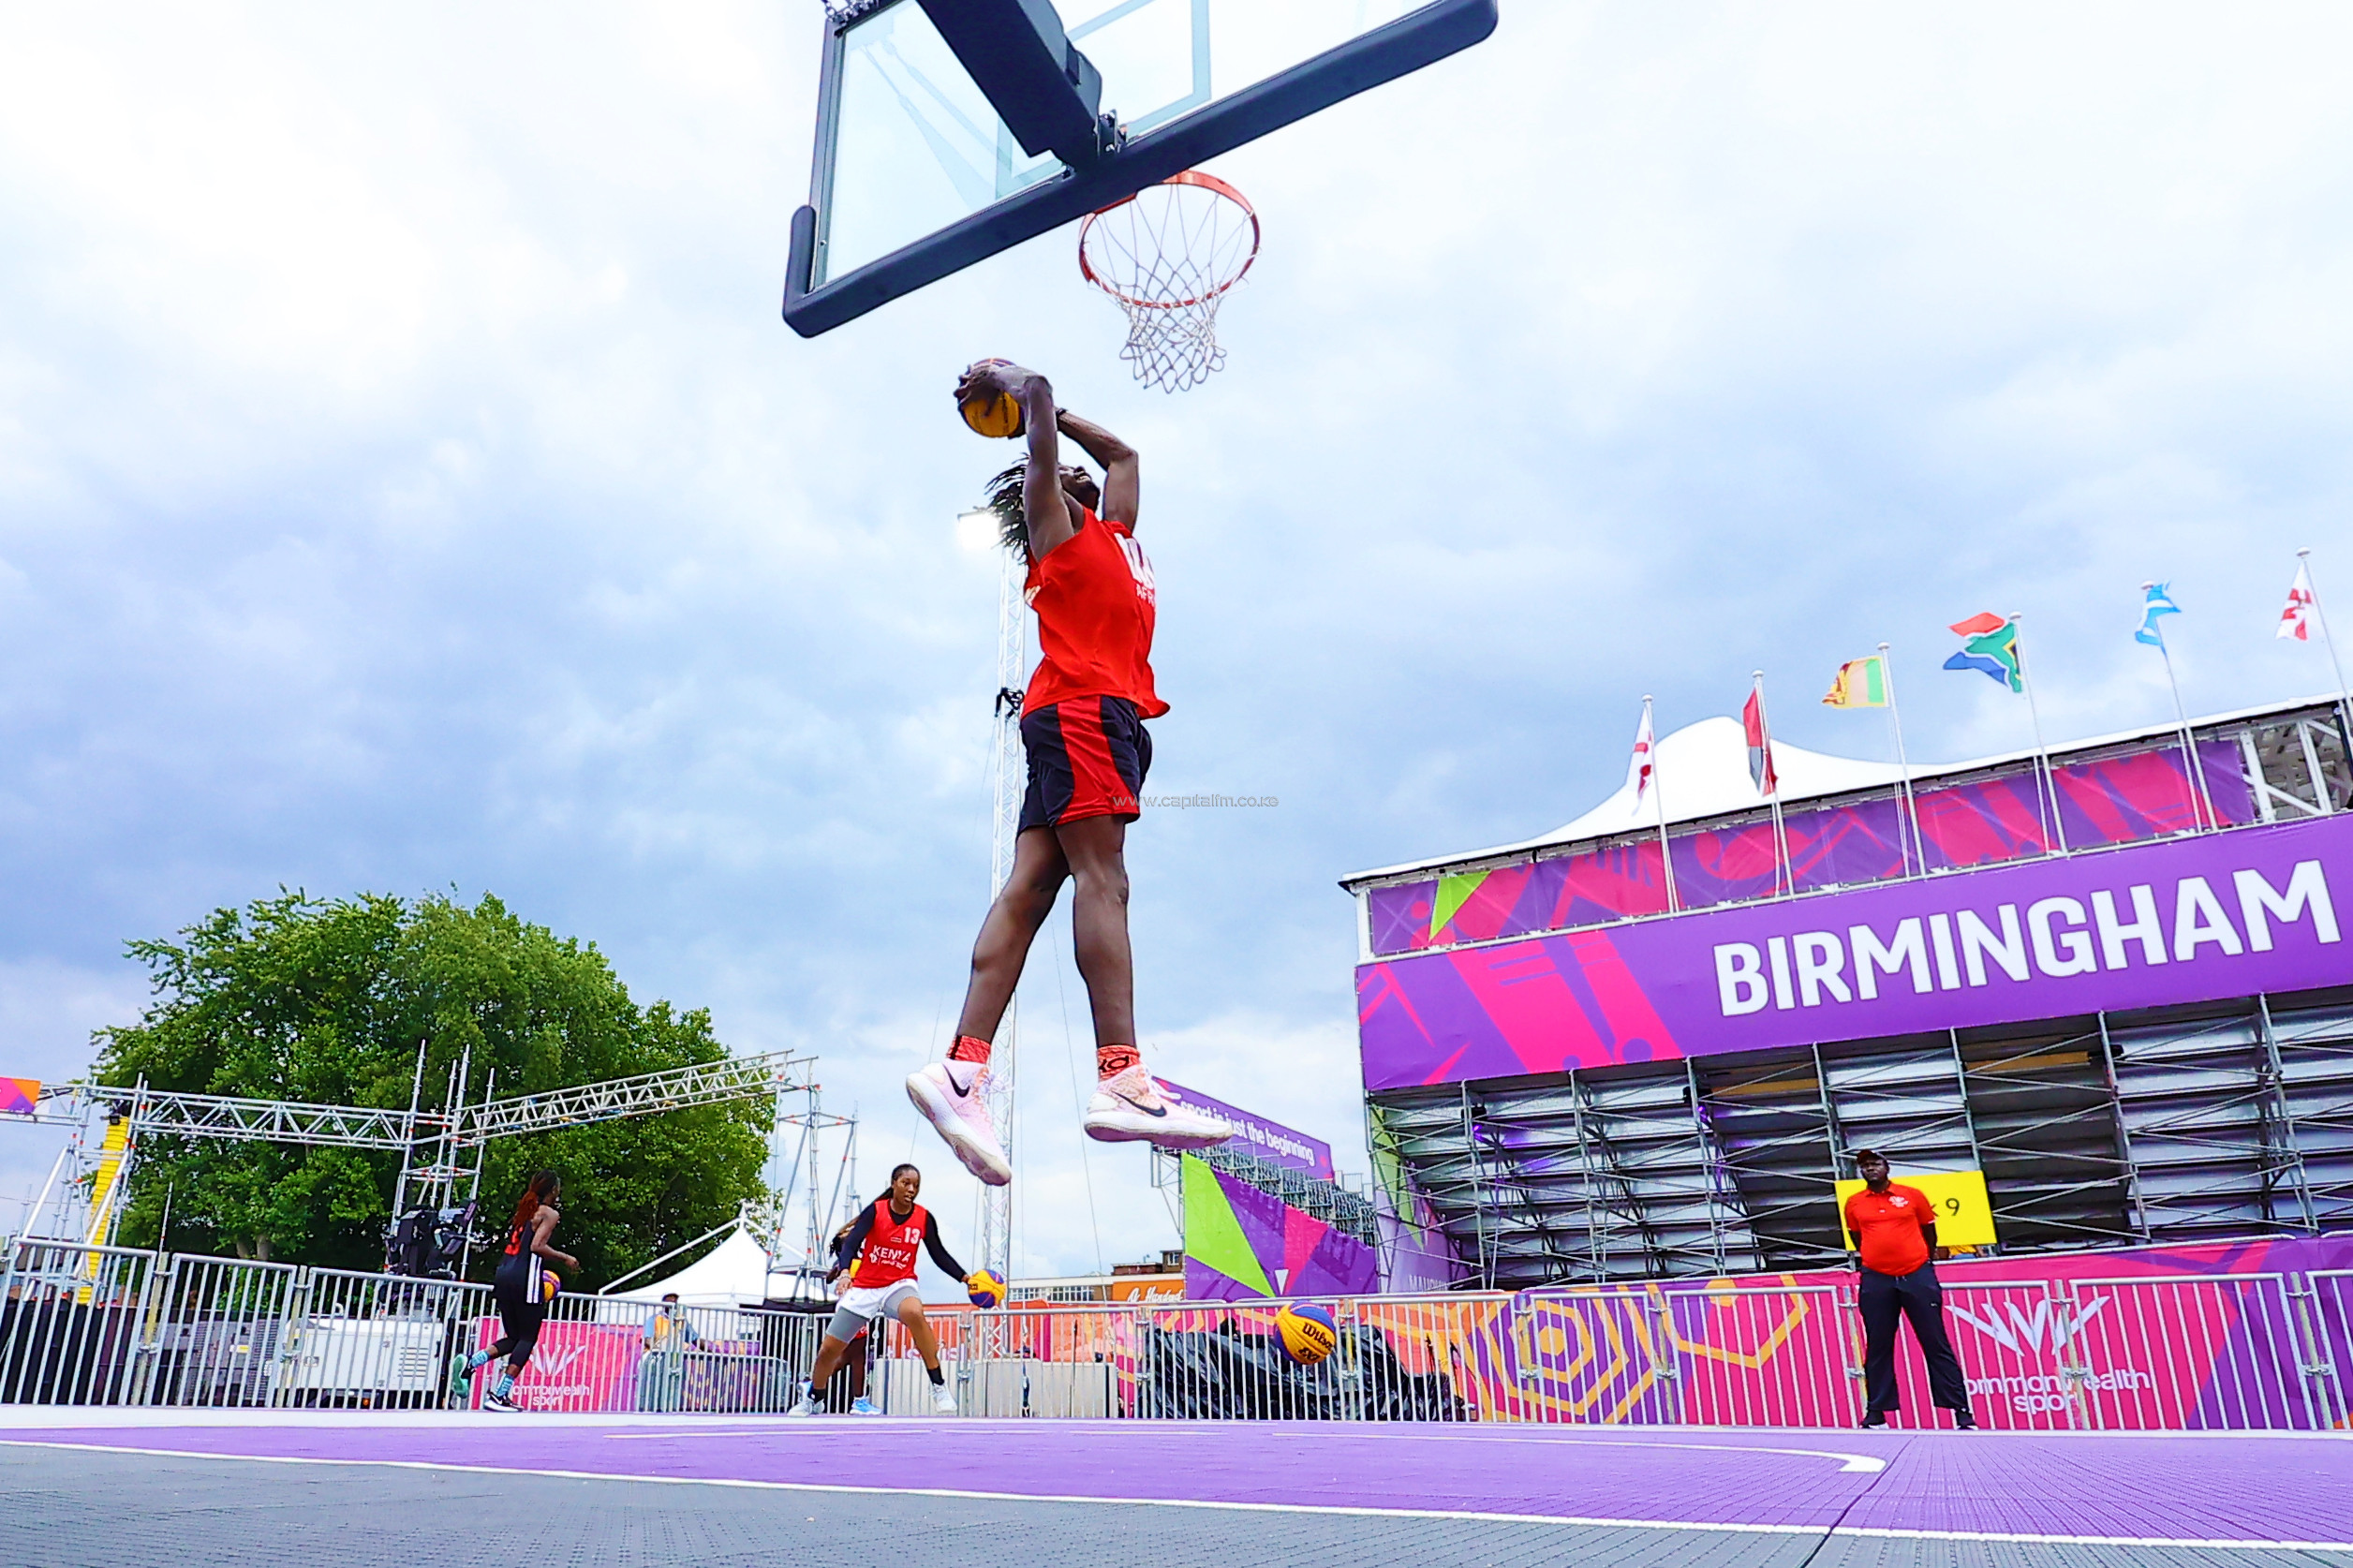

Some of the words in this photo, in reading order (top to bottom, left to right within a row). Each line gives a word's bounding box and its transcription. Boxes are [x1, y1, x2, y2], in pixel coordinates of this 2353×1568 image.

[1712, 858, 2342, 1017] BIRMINGHAM
[1247, 1121, 1265, 1146] the
[1265, 1127, 1316, 1167] beginning
[1946, 1197, 1960, 1216] 9
[904, 1226, 921, 1245] 13
[872, 1244, 911, 1263] KENYA
[1963, 1368, 2152, 1396] ommonealth
[2013, 1393, 2079, 1415] spor
